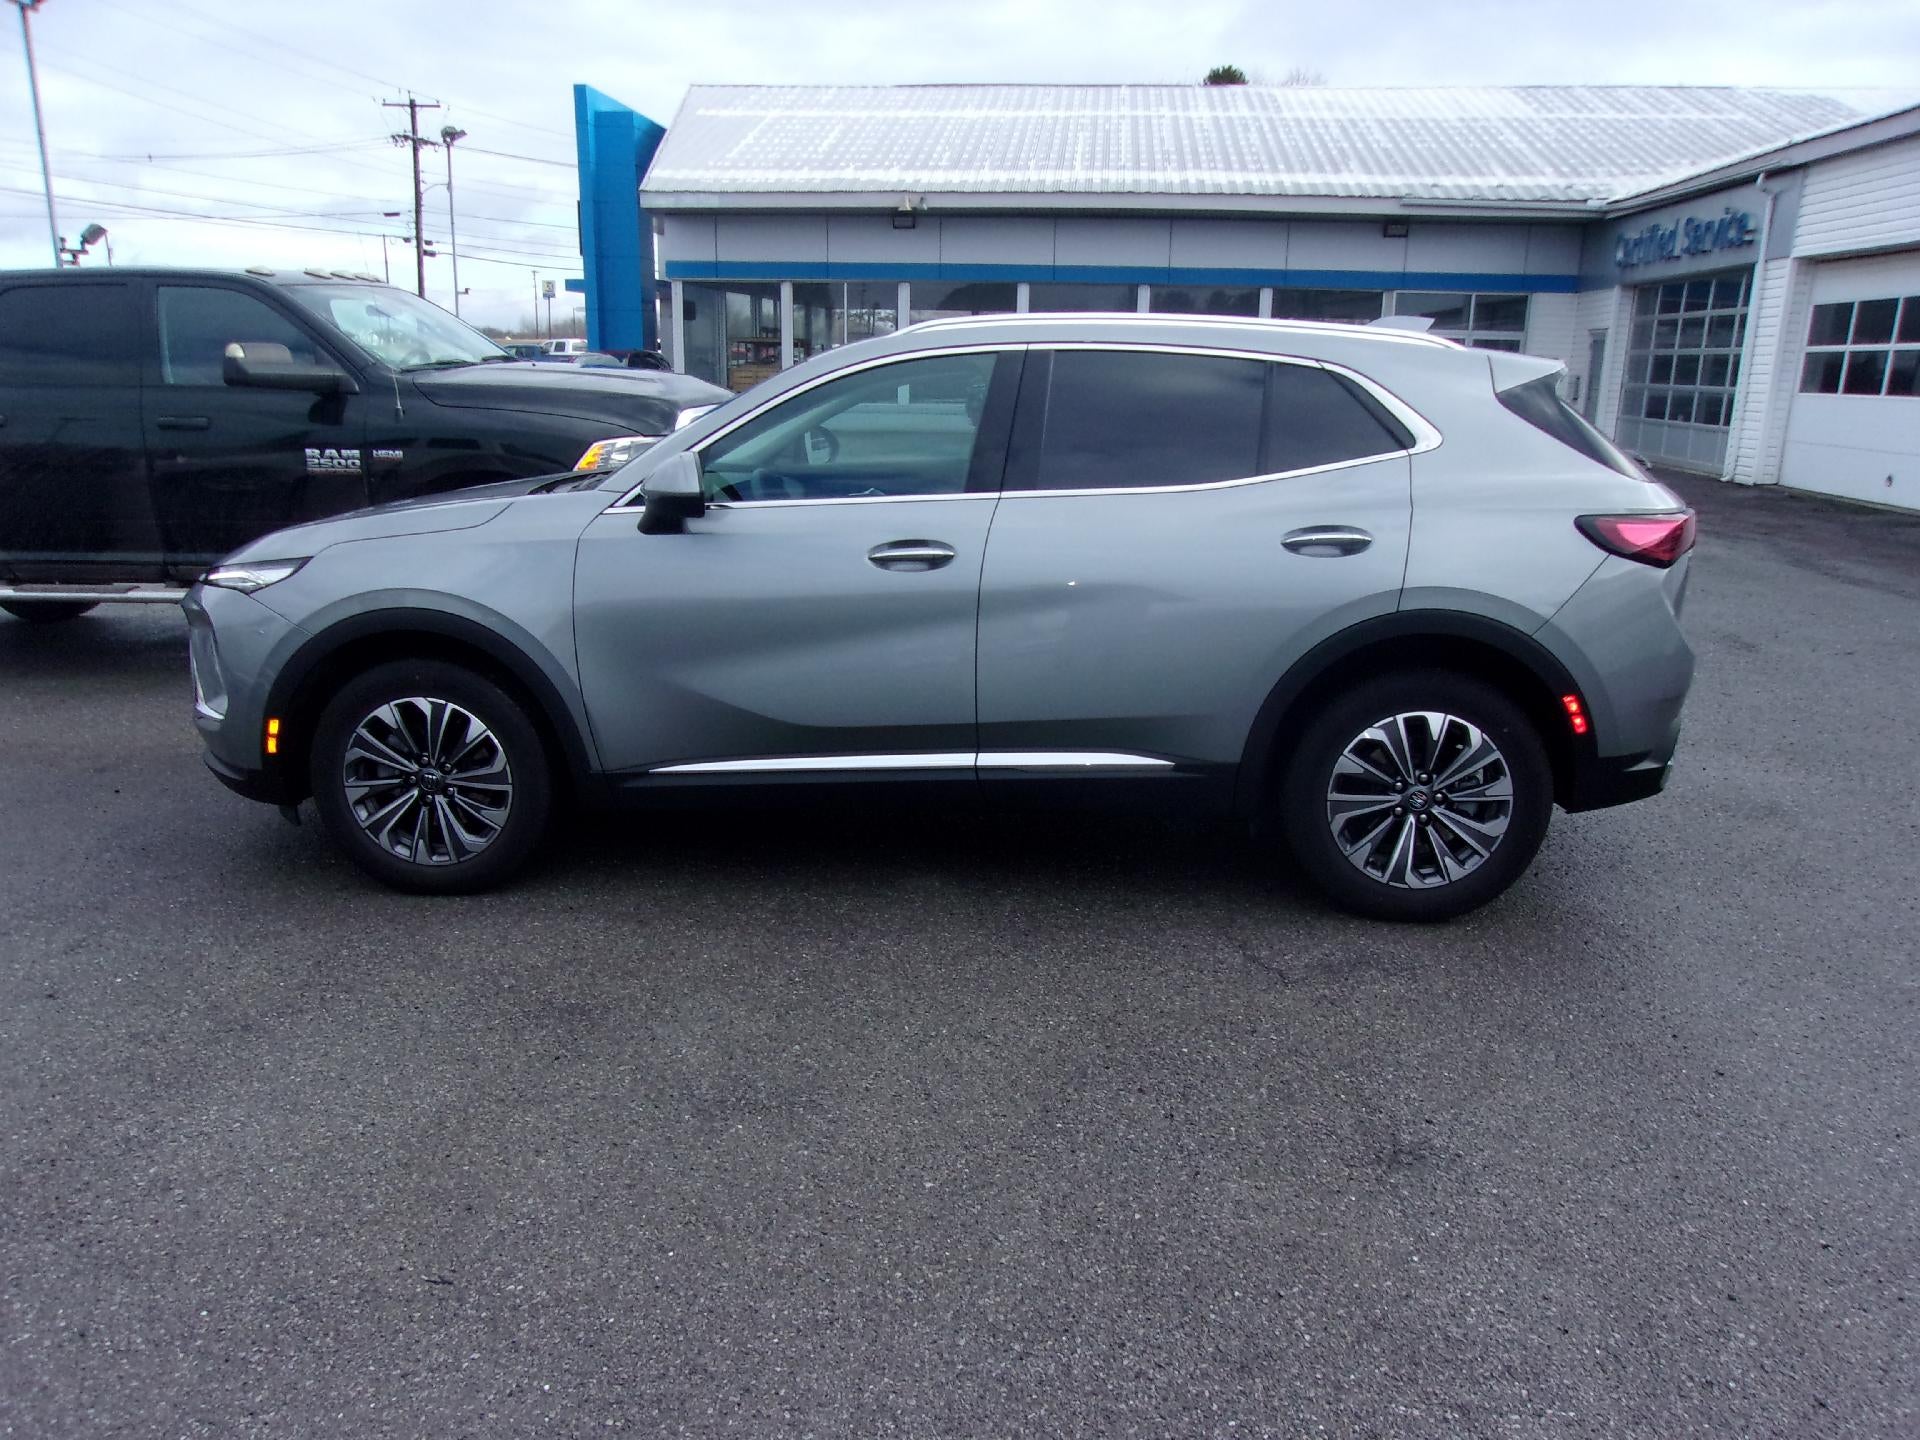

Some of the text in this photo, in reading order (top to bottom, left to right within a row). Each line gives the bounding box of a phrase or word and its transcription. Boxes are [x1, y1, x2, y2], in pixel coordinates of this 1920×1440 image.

[1683, 207, 1755, 256] Service
[304, 447, 361, 459] RAM
[372, 449, 404, 458] HEMI
[306, 458, 361, 469] 2500
